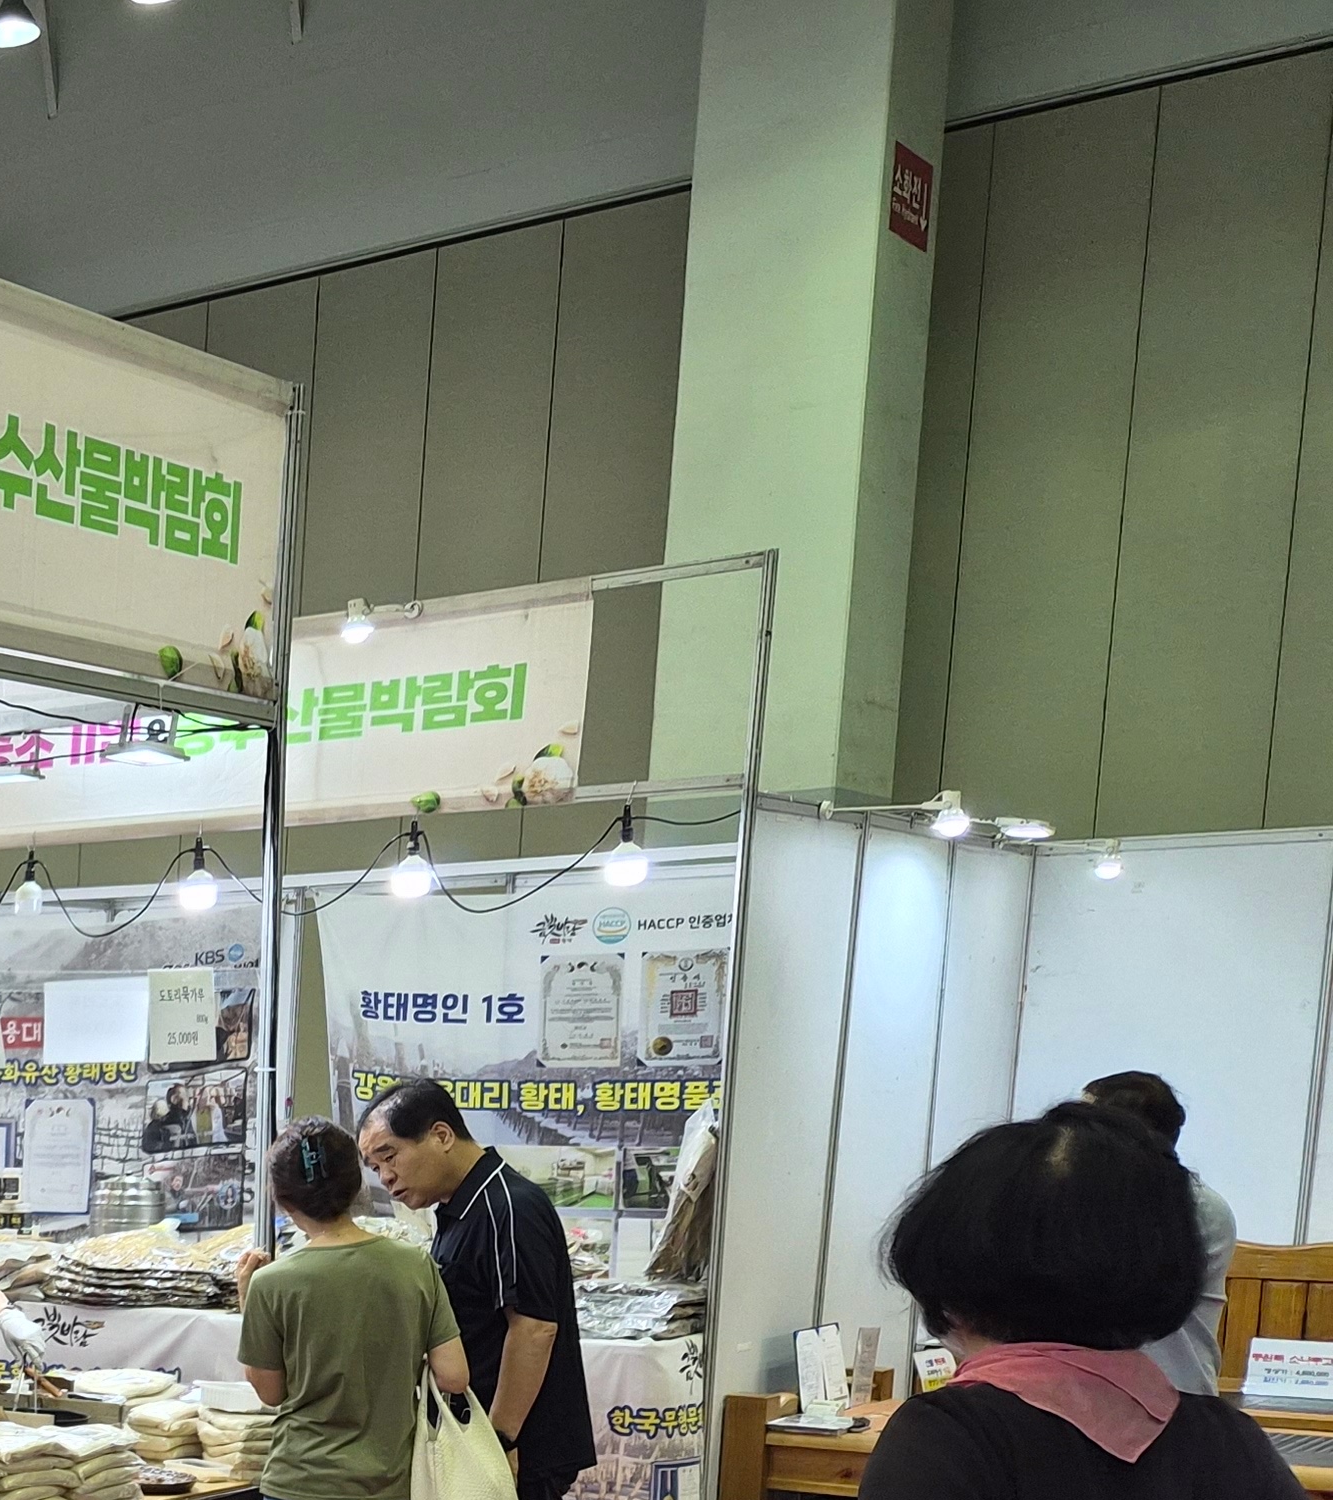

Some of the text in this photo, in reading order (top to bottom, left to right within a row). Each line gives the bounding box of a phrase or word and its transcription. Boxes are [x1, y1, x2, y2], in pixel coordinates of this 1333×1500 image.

[893, 164, 922, 210] 소화전
[638, 918, 684, 930] HACCP
[195, 949, 225, 966] KBS
[159, 986, 205, 1003] 도토리묵가루
[361, 990, 525, 1024] 황태명인 1호
[167, 1031, 199, 1045] 25,000원
[519, 1082, 585, 1114] 황태,
